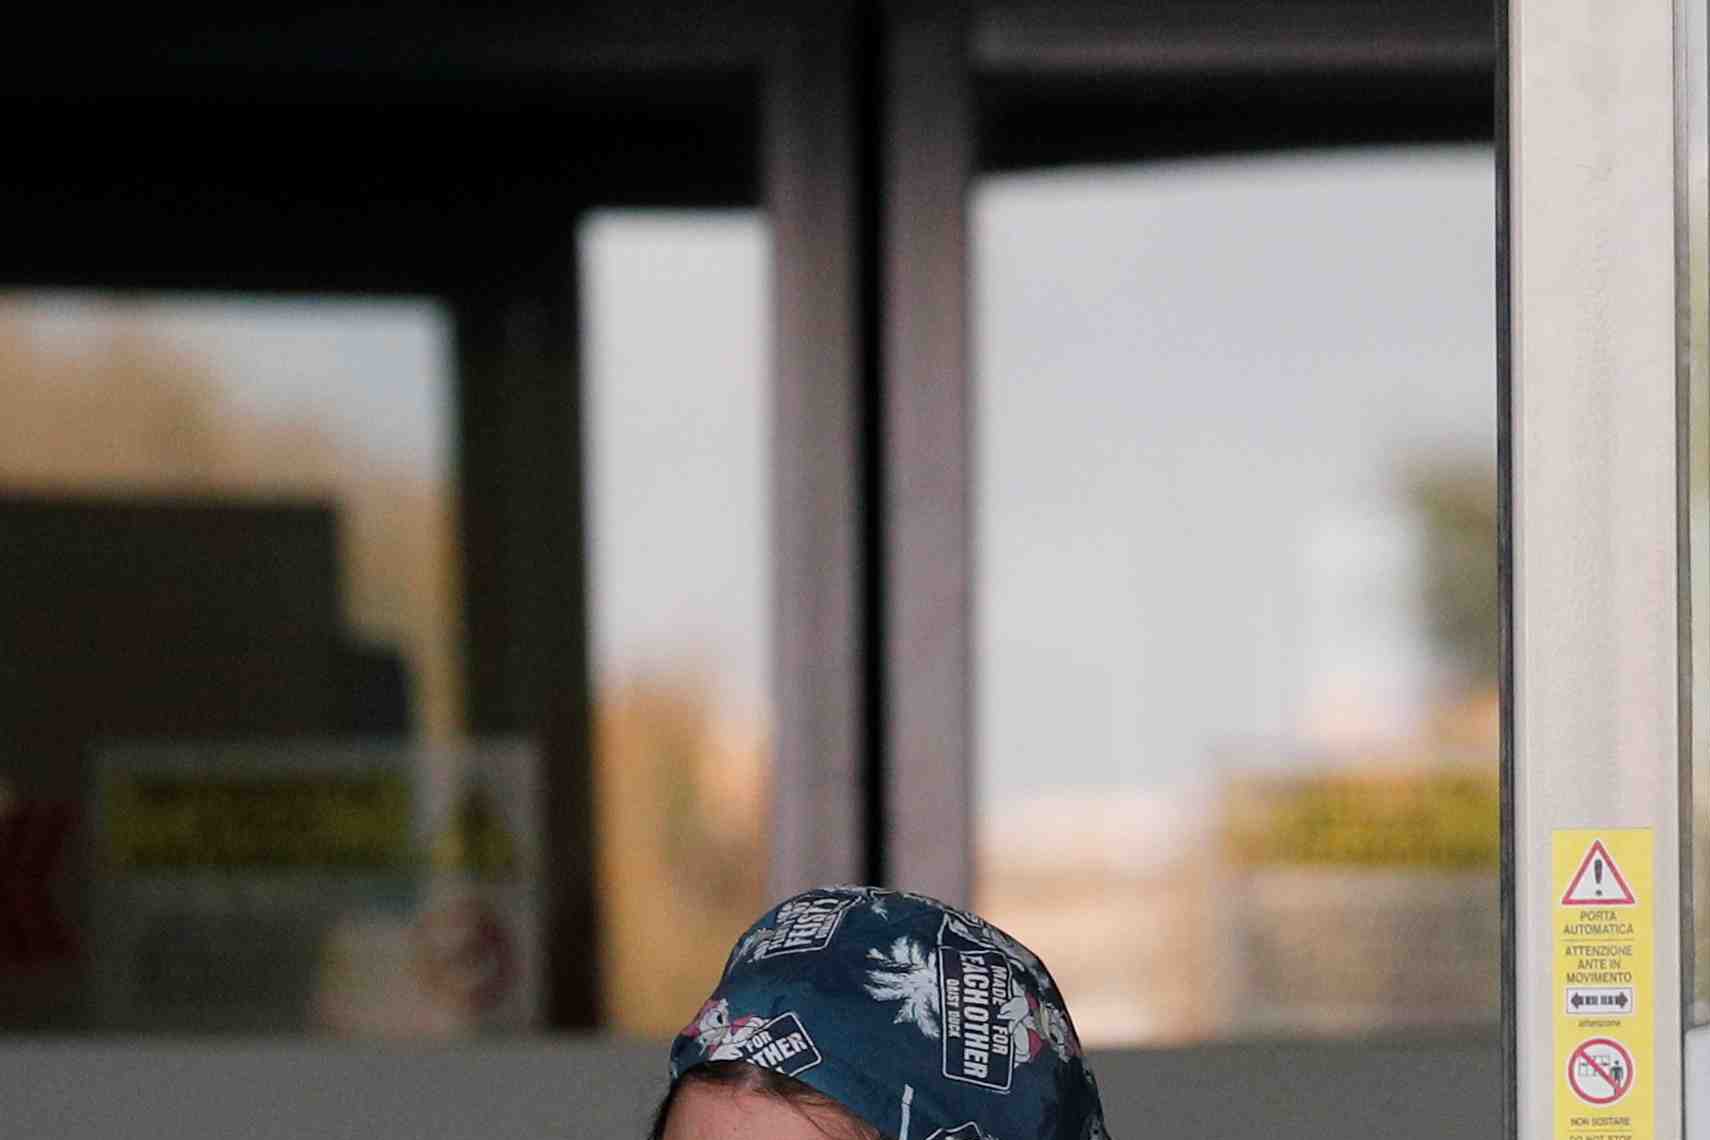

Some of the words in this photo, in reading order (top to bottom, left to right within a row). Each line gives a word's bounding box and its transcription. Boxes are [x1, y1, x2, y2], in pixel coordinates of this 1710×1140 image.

[1579, 911, 1617, 921] PORTA
[1563, 923, 1634, 935] AUTOMATICA
[1565, 945, 1633, 957] ATTENZIONE
[1567, 971, 1633, 983] MOVIMENTO
[745, 1030, 773, 1053] FOR
[991, 1025, 1009, 1056] FOR
[748, 1032, 808, 1068] THER
